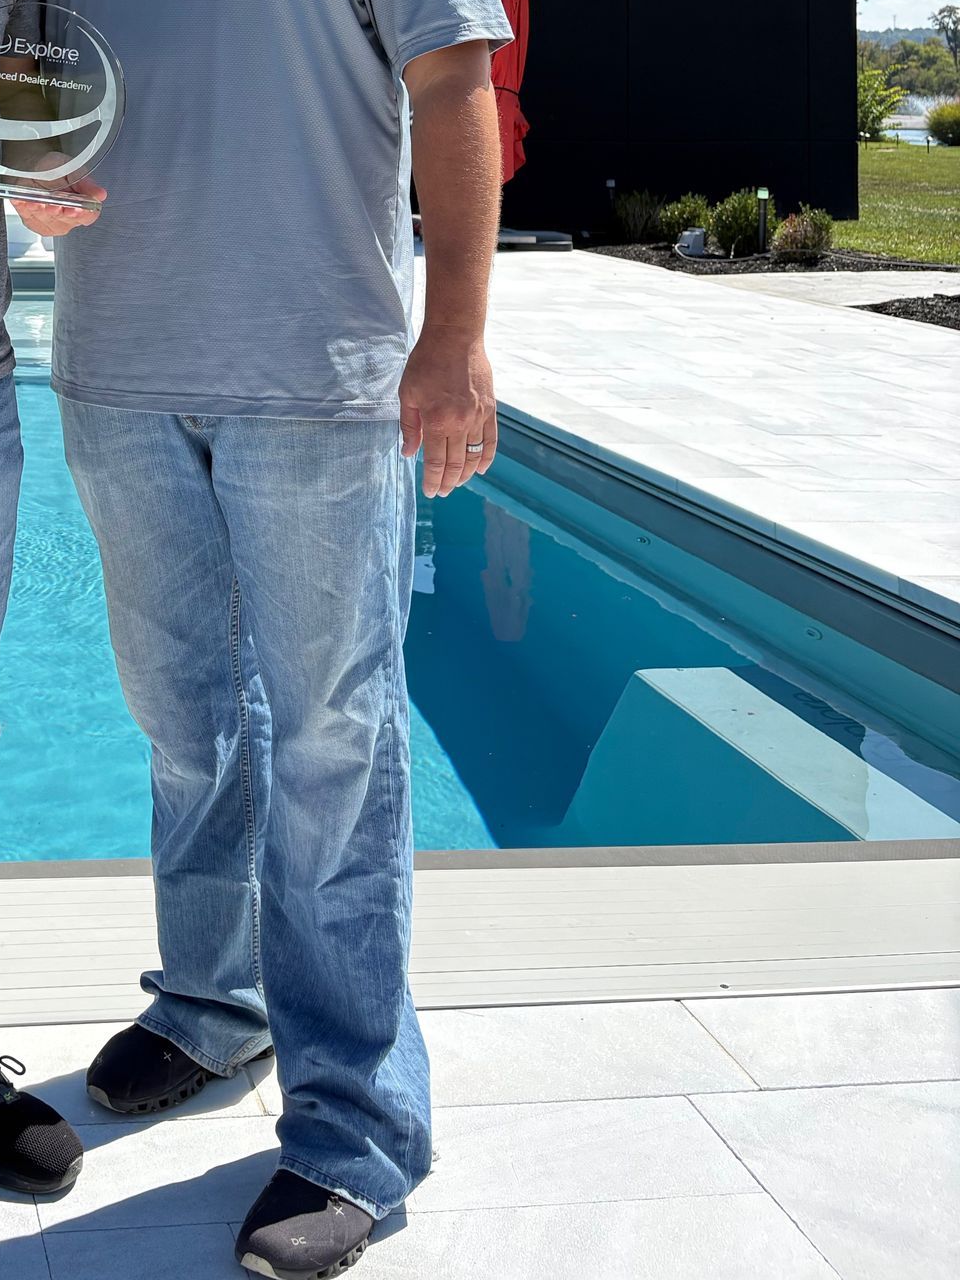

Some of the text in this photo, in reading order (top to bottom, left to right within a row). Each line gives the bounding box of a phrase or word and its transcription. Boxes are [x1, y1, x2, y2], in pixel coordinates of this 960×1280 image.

[13, 37, 80, 61] Explore
[19, 73, 49, 86] Dealer
[50, 77, 93, 93] Academy
